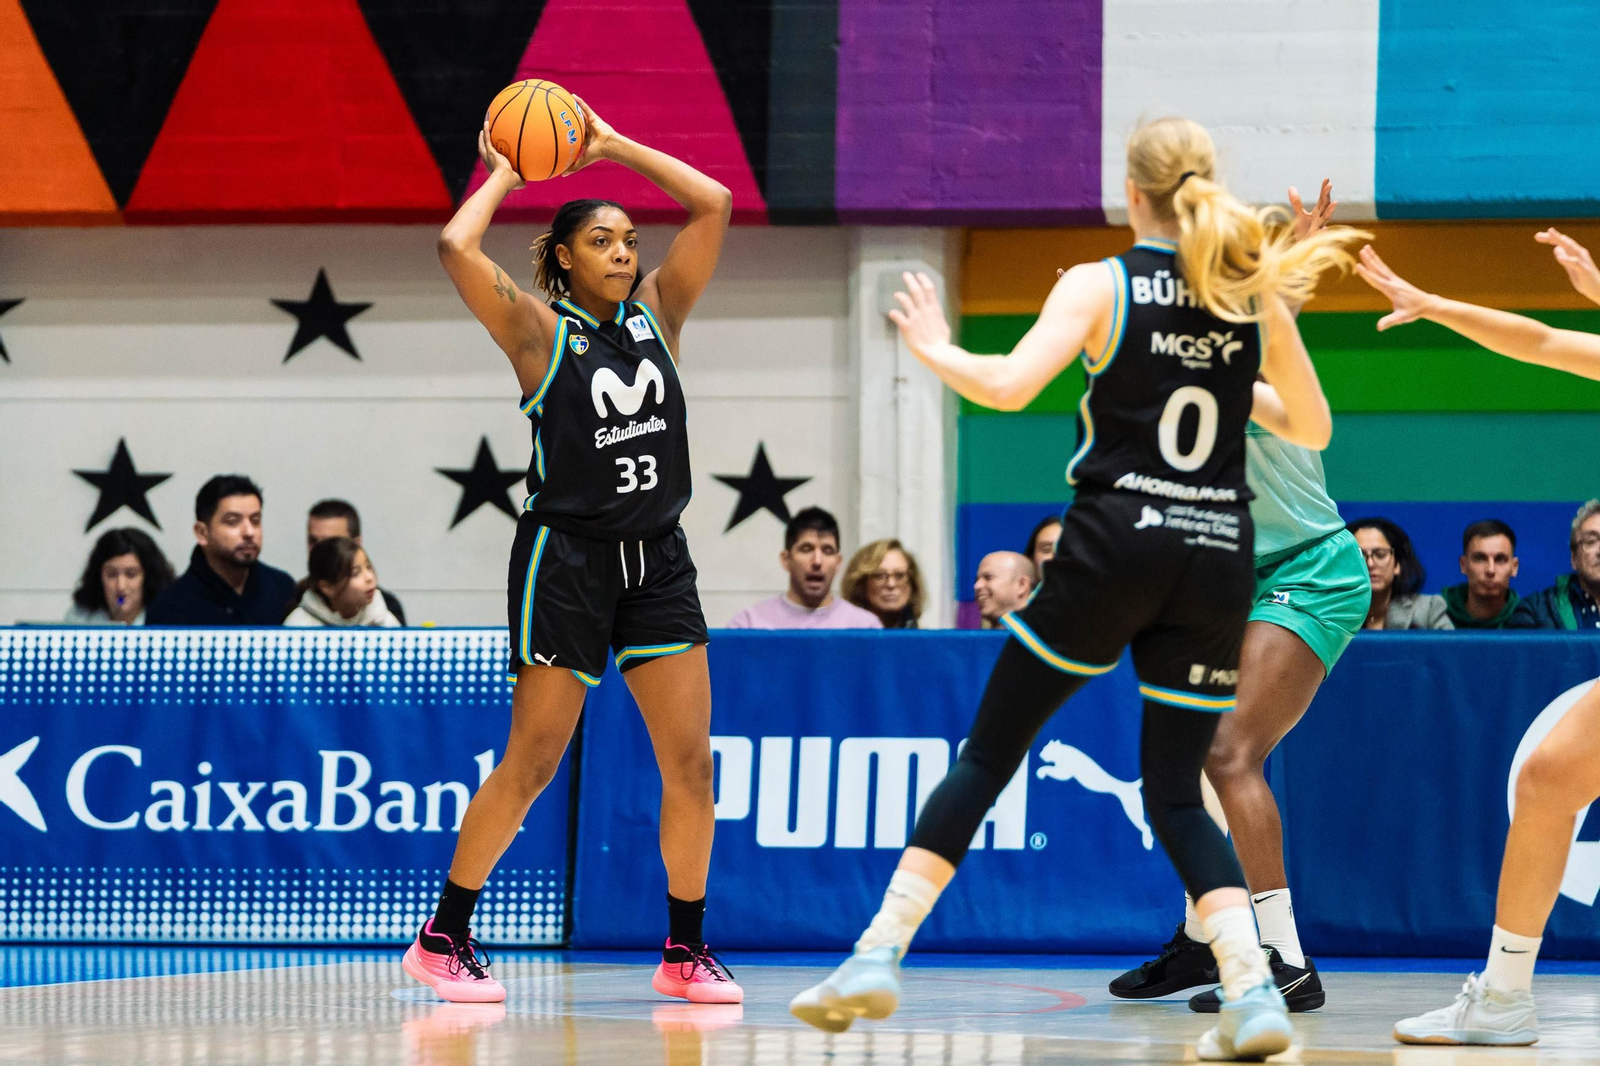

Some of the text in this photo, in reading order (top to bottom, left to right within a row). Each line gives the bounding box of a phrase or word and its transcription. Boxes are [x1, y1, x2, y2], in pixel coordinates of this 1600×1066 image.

[1131, 269, 1203, 308] BÜH
[1150, 331, 1213, 361] MGS
[594, 415, 667, 450] Estudiantes
[1158, 385, 1219, 473] 0
[615, 454, 659, 494] 33
